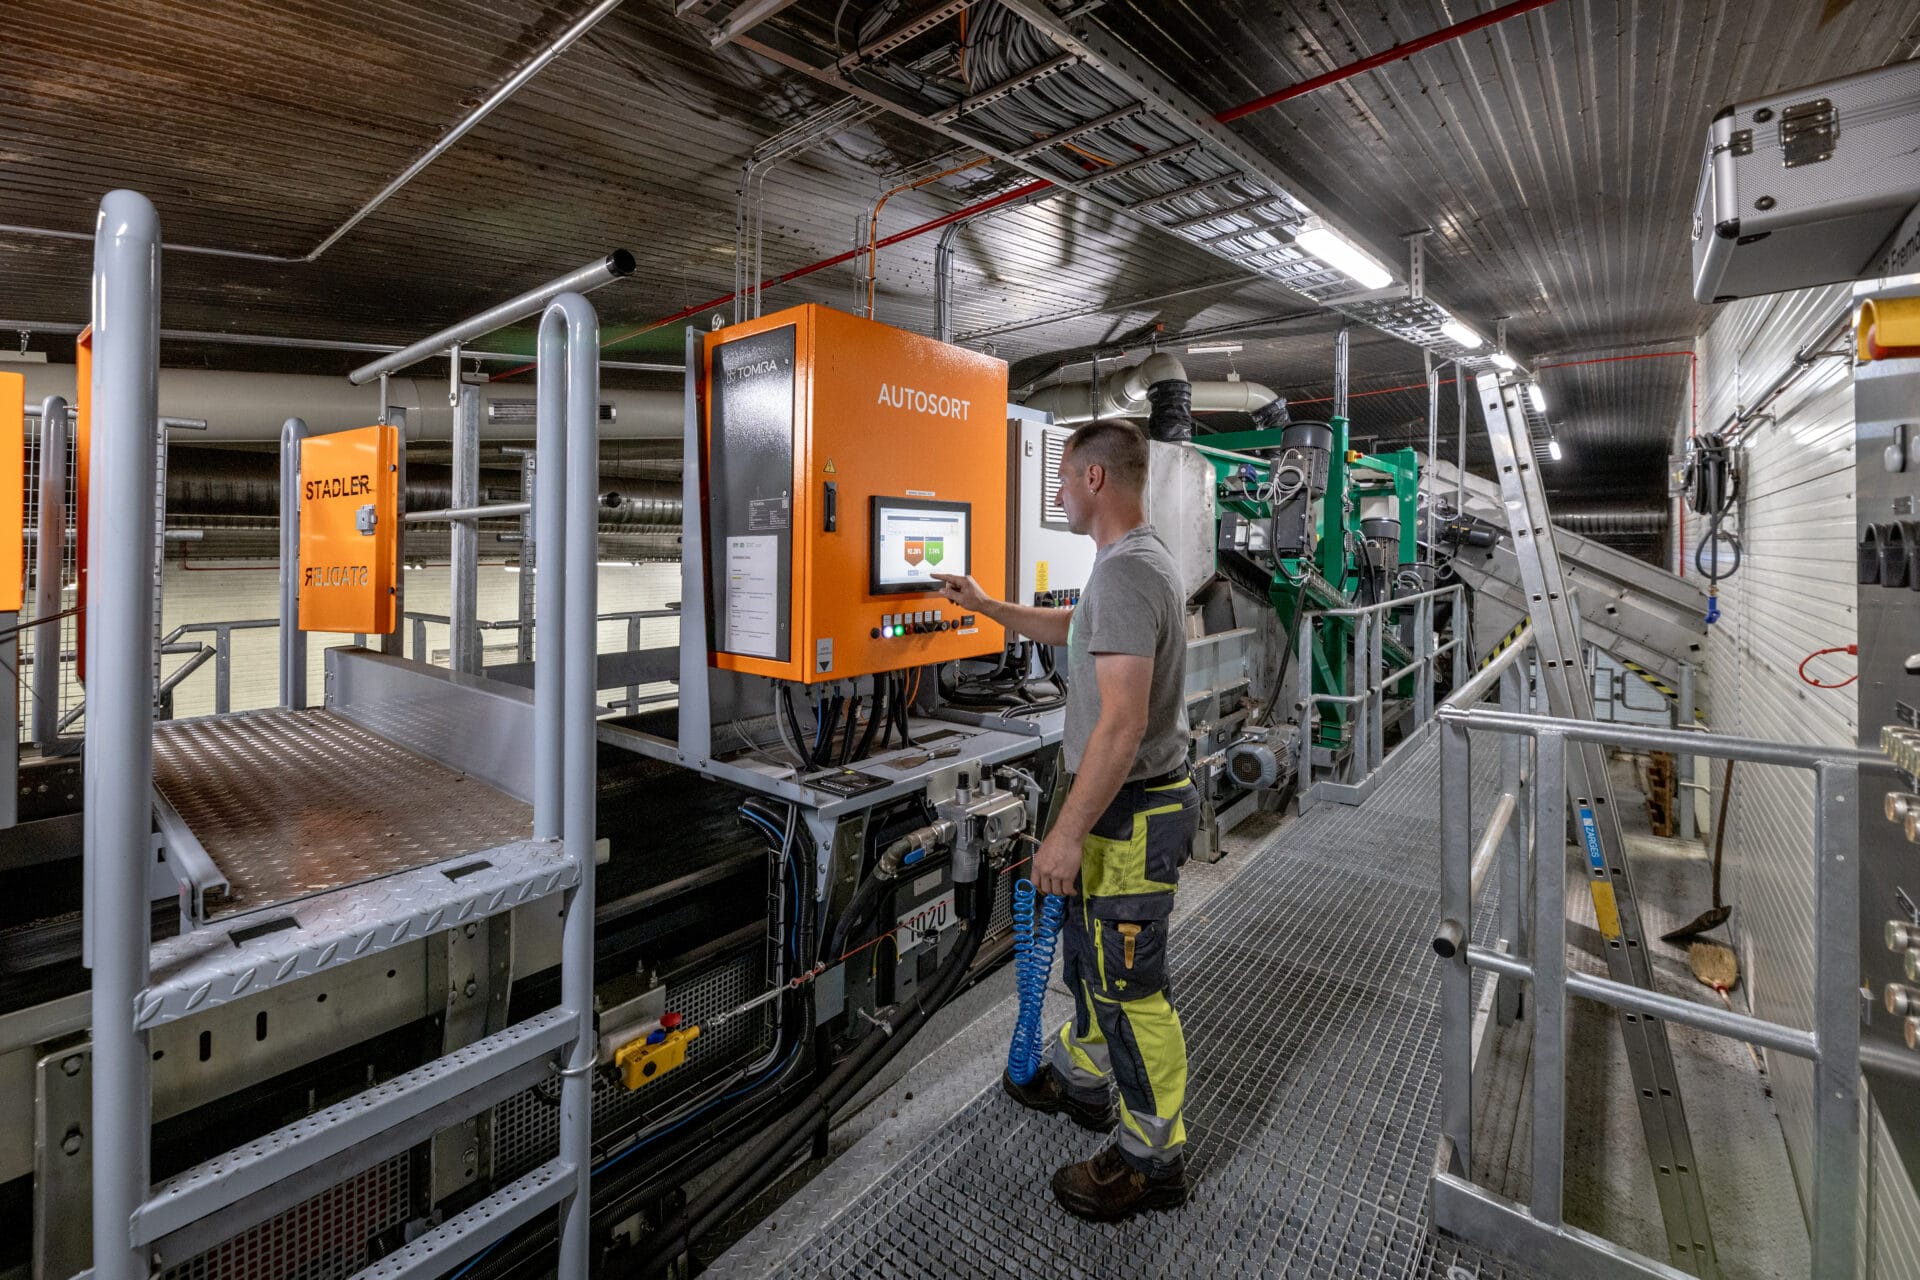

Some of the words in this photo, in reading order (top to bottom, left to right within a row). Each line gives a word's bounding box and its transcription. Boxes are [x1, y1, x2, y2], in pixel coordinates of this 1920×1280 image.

[737, 359, 778, 379] TOMRA
[877, 382, 971, 421] AUTOSORT
[305, 474, 370, 501] STADLER
[1584, 826, 1600, 858] ZARGES
